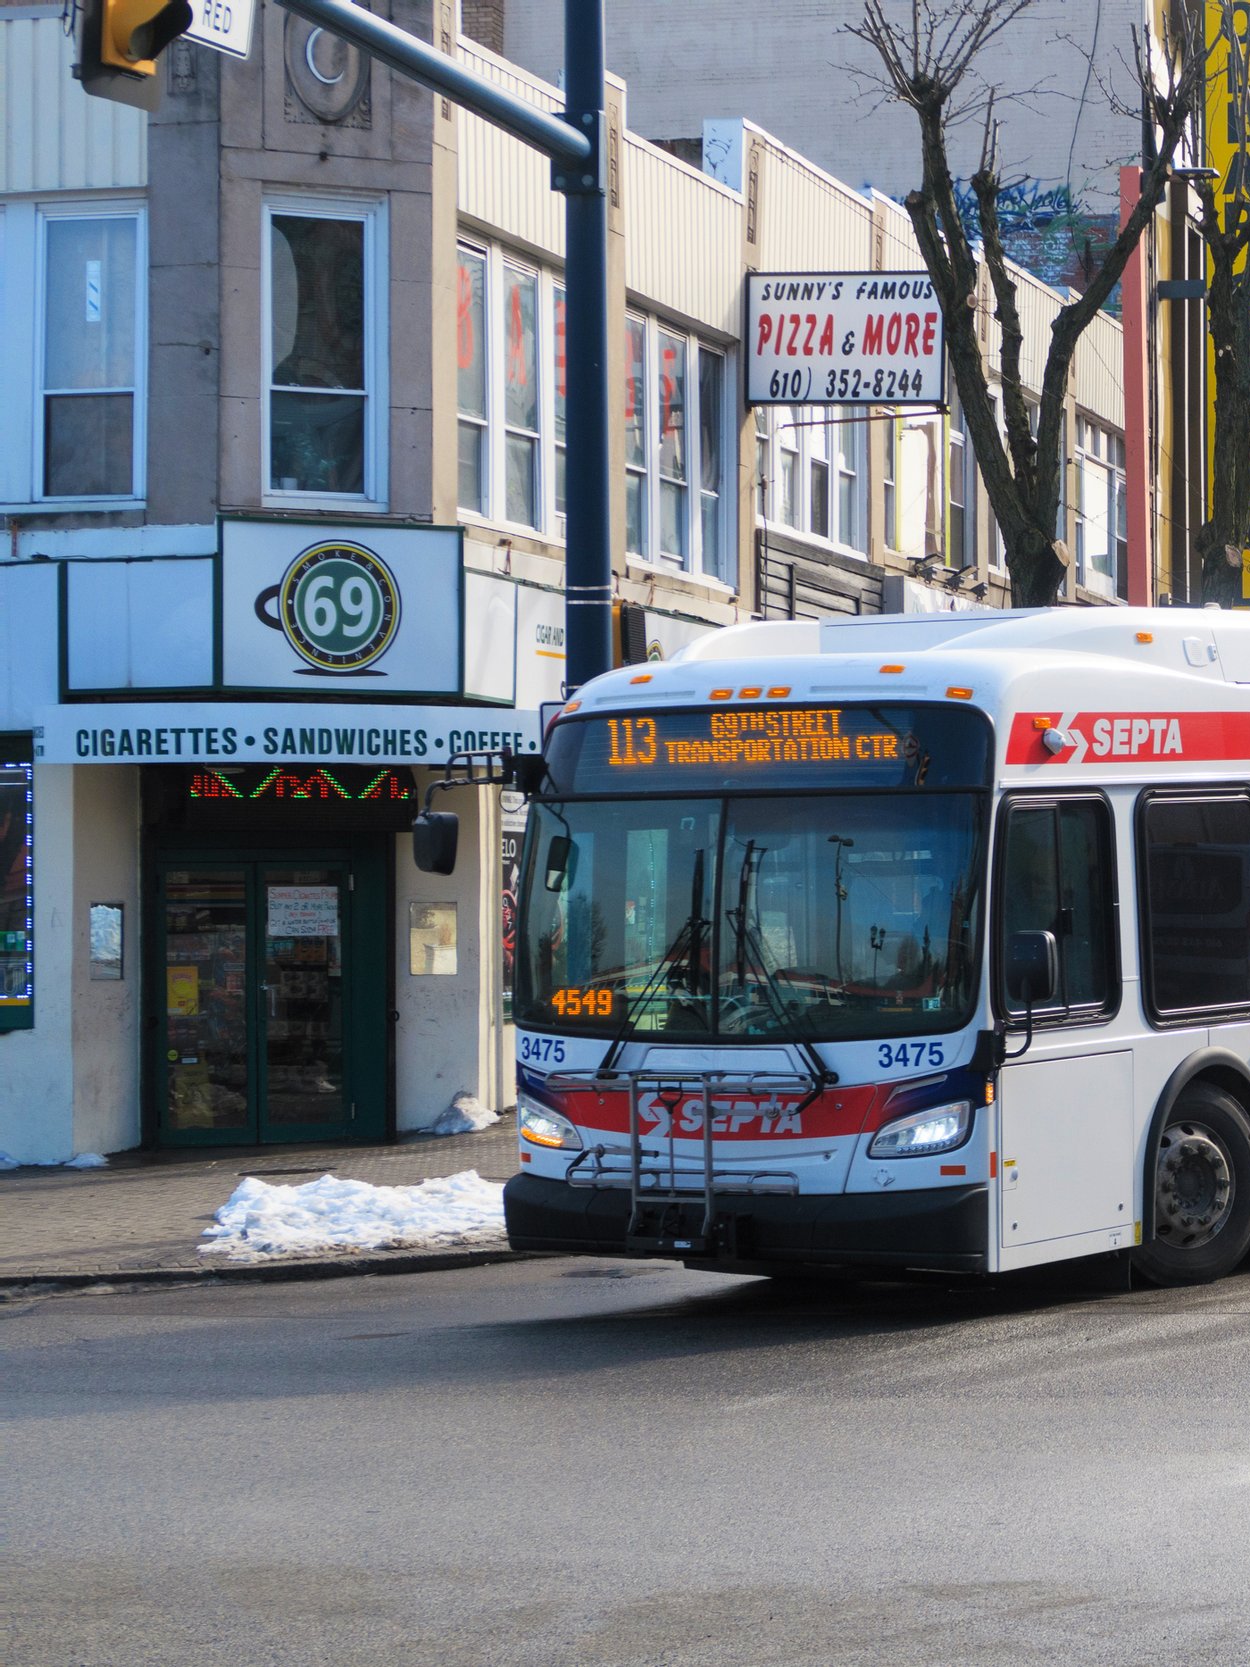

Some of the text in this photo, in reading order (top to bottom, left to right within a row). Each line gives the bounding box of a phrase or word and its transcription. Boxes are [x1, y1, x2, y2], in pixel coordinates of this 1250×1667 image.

[202, 0, 232, 33] RED
[761, 280, 933, 301] SUNNY'S FAMOUS
[757, 312, 938, 358] PIZZA & MORE
[769, 366, 923, 400] 610) 352-8244
[292, 549, 358, 584] SMOKE
[290, 578, 392, 664] CONVENIENCE
[304, 575, 374, 638] 69
[75, 726, 239, 757] CIGARETTES
[262, 726, 428, 757] SANDWICHES
[449, 730, 523, 756] COFFEE
[607, 718, 657, 765] 113
[664, 735, 898, 763] TRANSPORTATION CTR
[1092, 718, 1183, 756] SEPTA
[502, 838, 516, 858] ELO
[552, 989, 613, 1016] 4549
[521, 1037, 565, 1063] 3475
[878, 1042, 945, 1069] 3475
[679, 1099, 803, 1134] SEPTA
